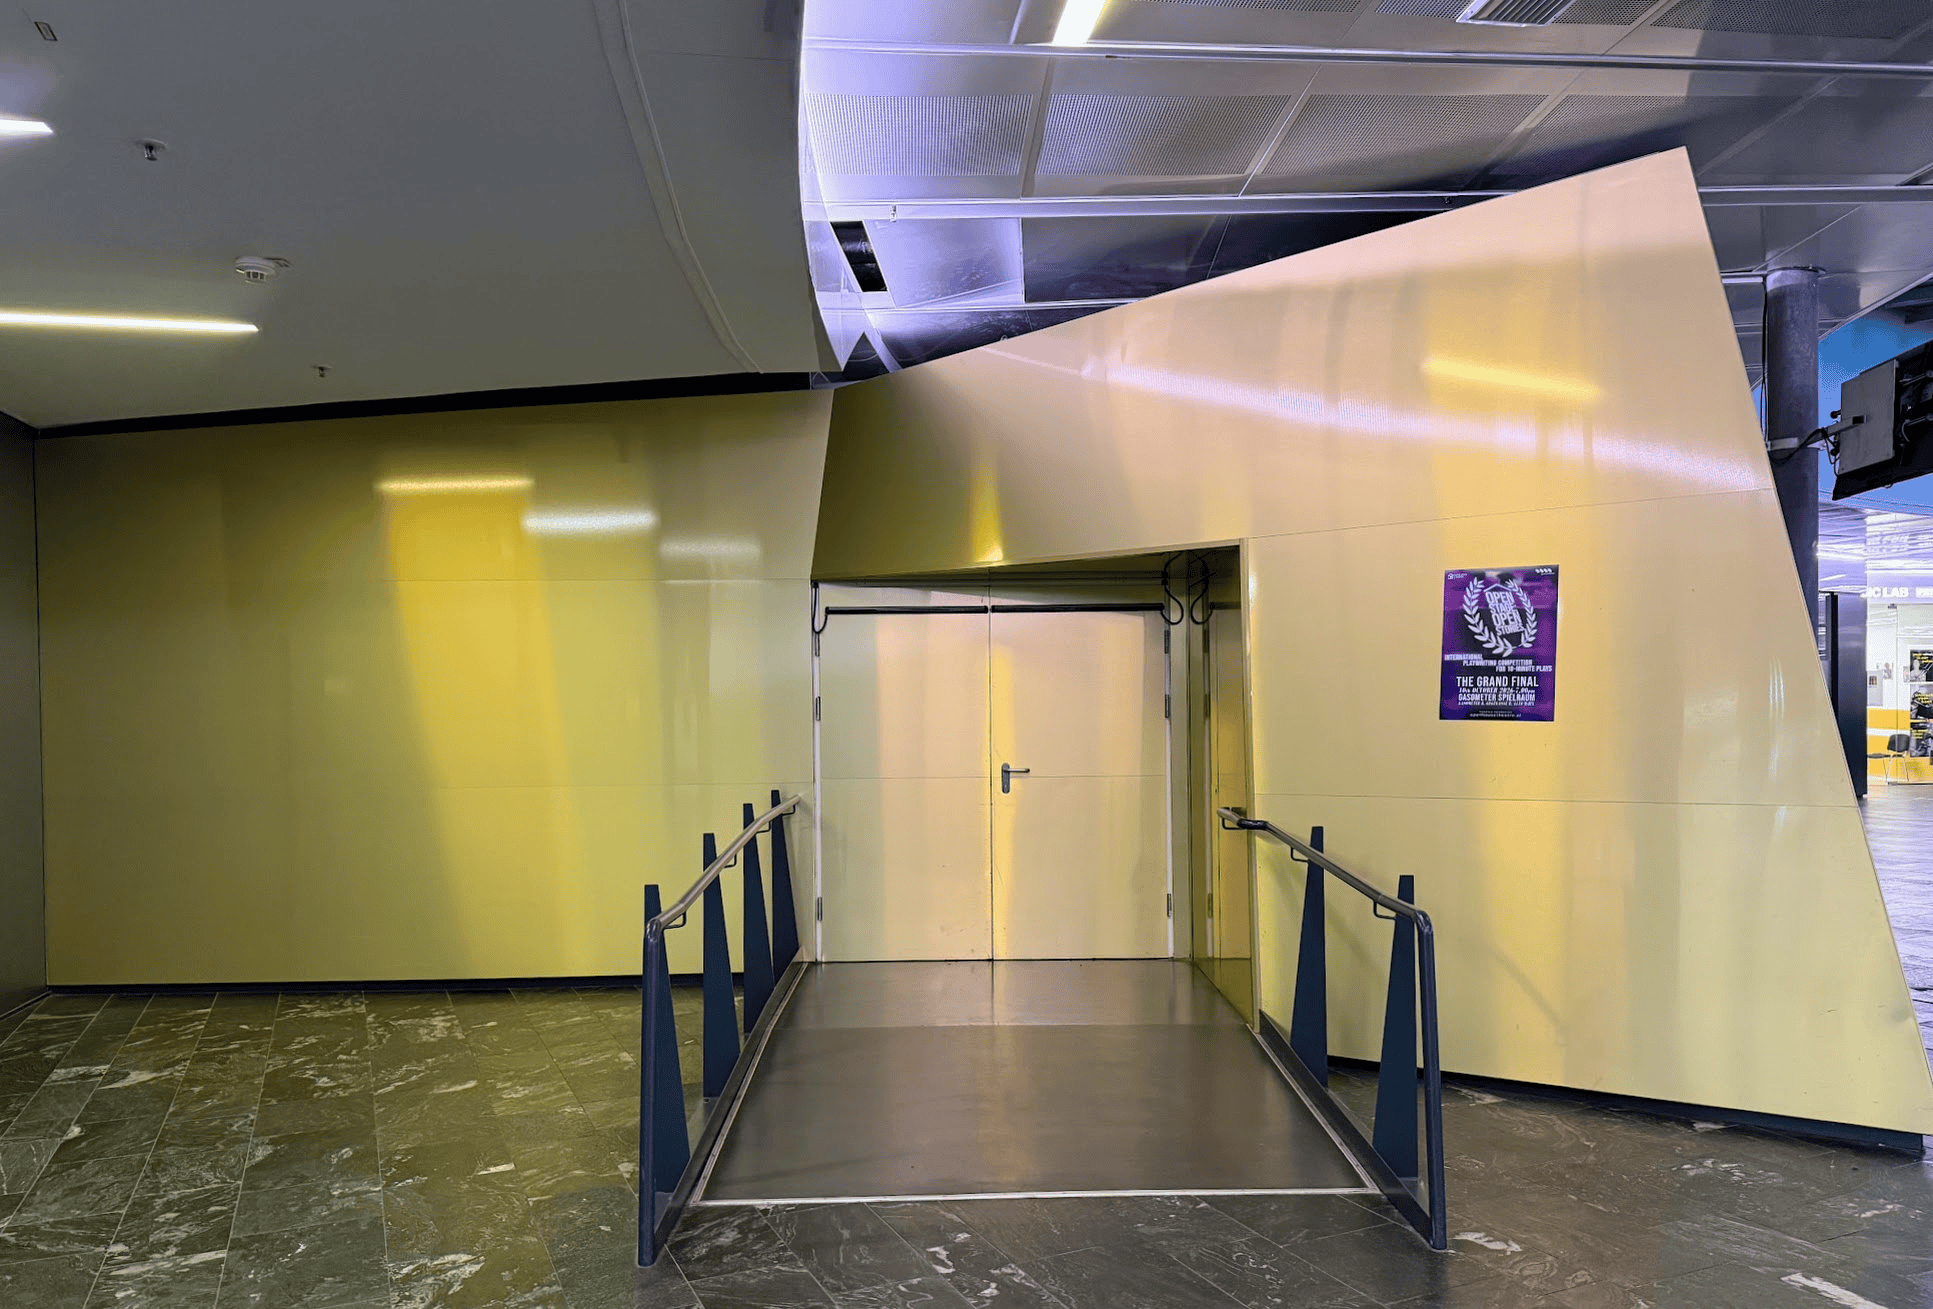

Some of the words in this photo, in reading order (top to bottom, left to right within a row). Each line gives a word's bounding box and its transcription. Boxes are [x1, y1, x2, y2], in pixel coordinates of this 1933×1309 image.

[1485, 592, 1515, 604] OPEN
[1882, 587, 1909, 598] LAB
[1491, 609, 1522, 626] OPEN
[1456, 676, 1474, 687] THE
[1477, 676, 1509, 687] GRAND
[1511, 675, 1539, 687] FINAL
[1458, 693, 1496, 701] GASOMETER
[1498, 693, 1536, 701] SPIELRAUM
